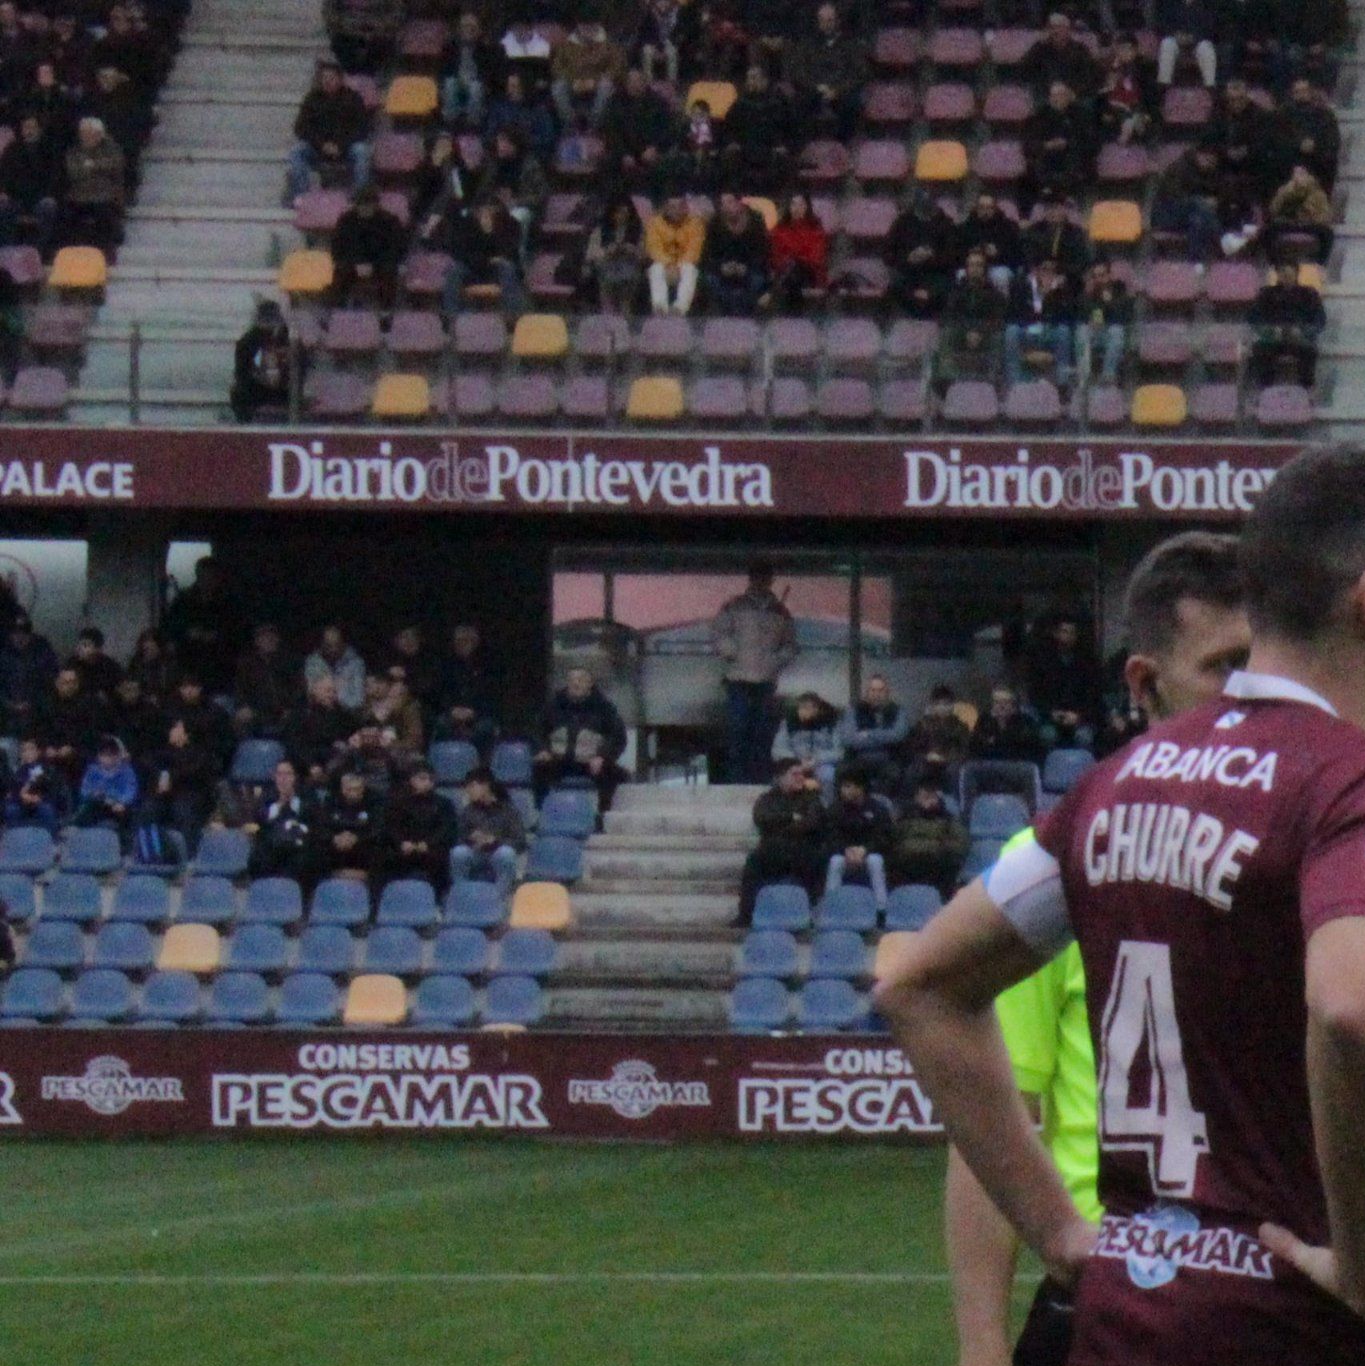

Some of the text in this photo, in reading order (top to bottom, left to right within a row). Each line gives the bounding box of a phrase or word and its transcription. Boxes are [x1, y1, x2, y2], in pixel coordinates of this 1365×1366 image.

[0, 461, 134, 498] ALACE
[1113, 742, 1279, 792] ABANCA
[1084, 804, 1260, 911] CHURRE
[299, 1044, 471, 1071] CONSERVAS
[1100, 940, 1210, 1199] 4
[41, 1076, 184, 1101] PESCAMAR
[211, 1073, 550, 1129] PESCAMAR
[568, 1079, 712, 1106] PESCAMAR
[737, 1078, 946, 1133] PESCA
